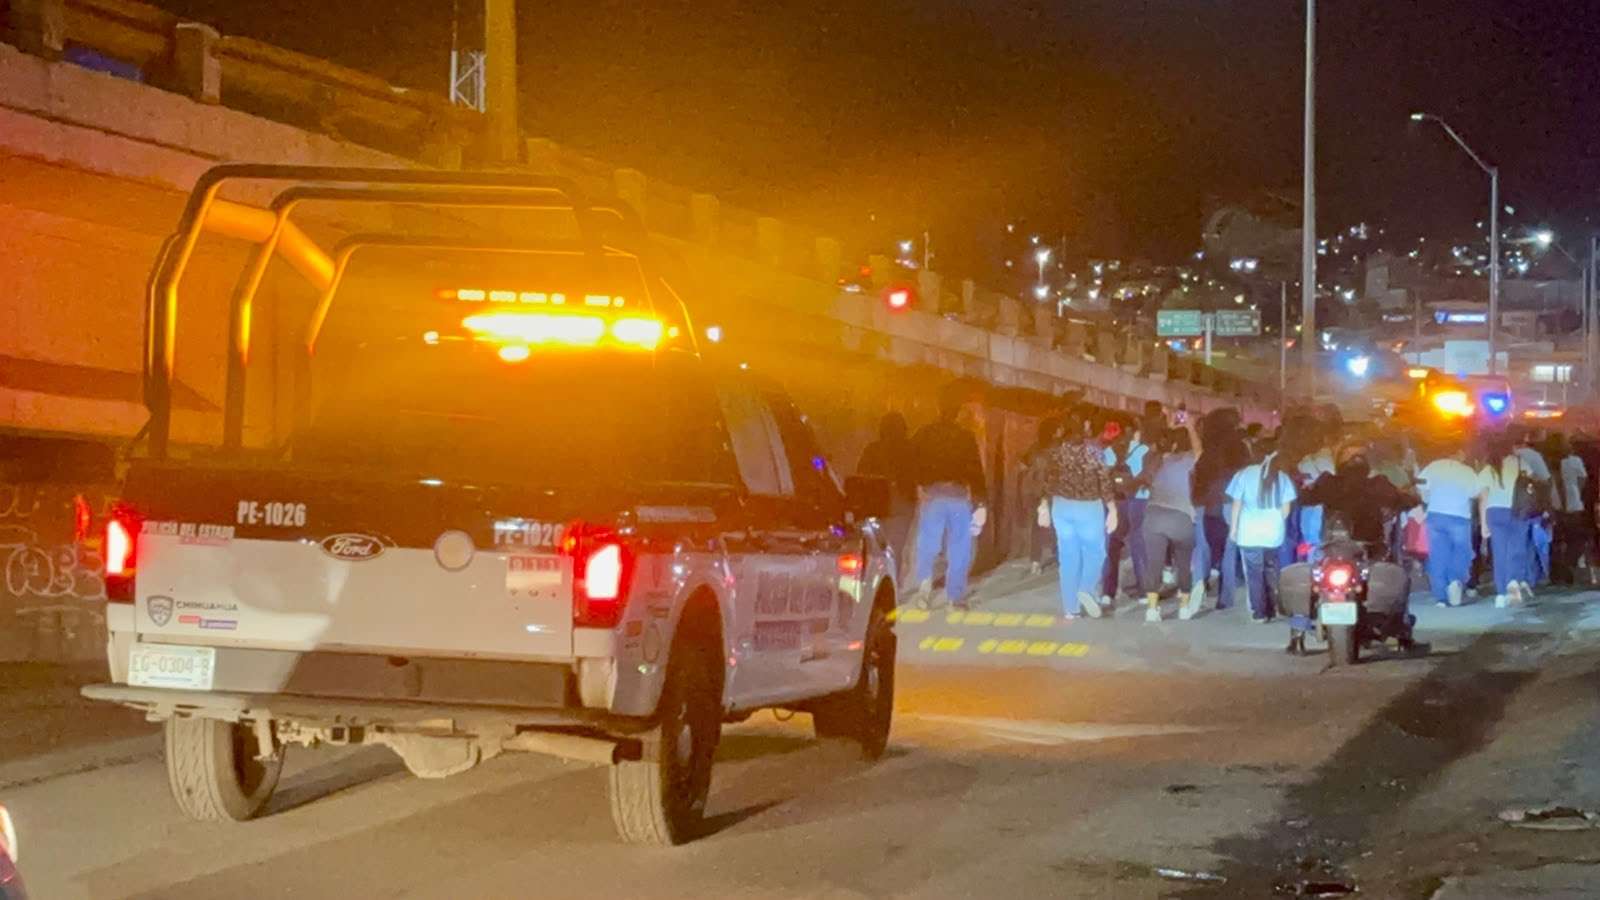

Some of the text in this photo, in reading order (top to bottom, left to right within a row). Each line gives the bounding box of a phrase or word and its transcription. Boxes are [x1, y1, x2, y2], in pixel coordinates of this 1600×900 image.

[236, 500, 306, 526] PE-1026
[330, 537, 373, 556] Ford
[176, 600, 238, 611] CHIHUAHUA
